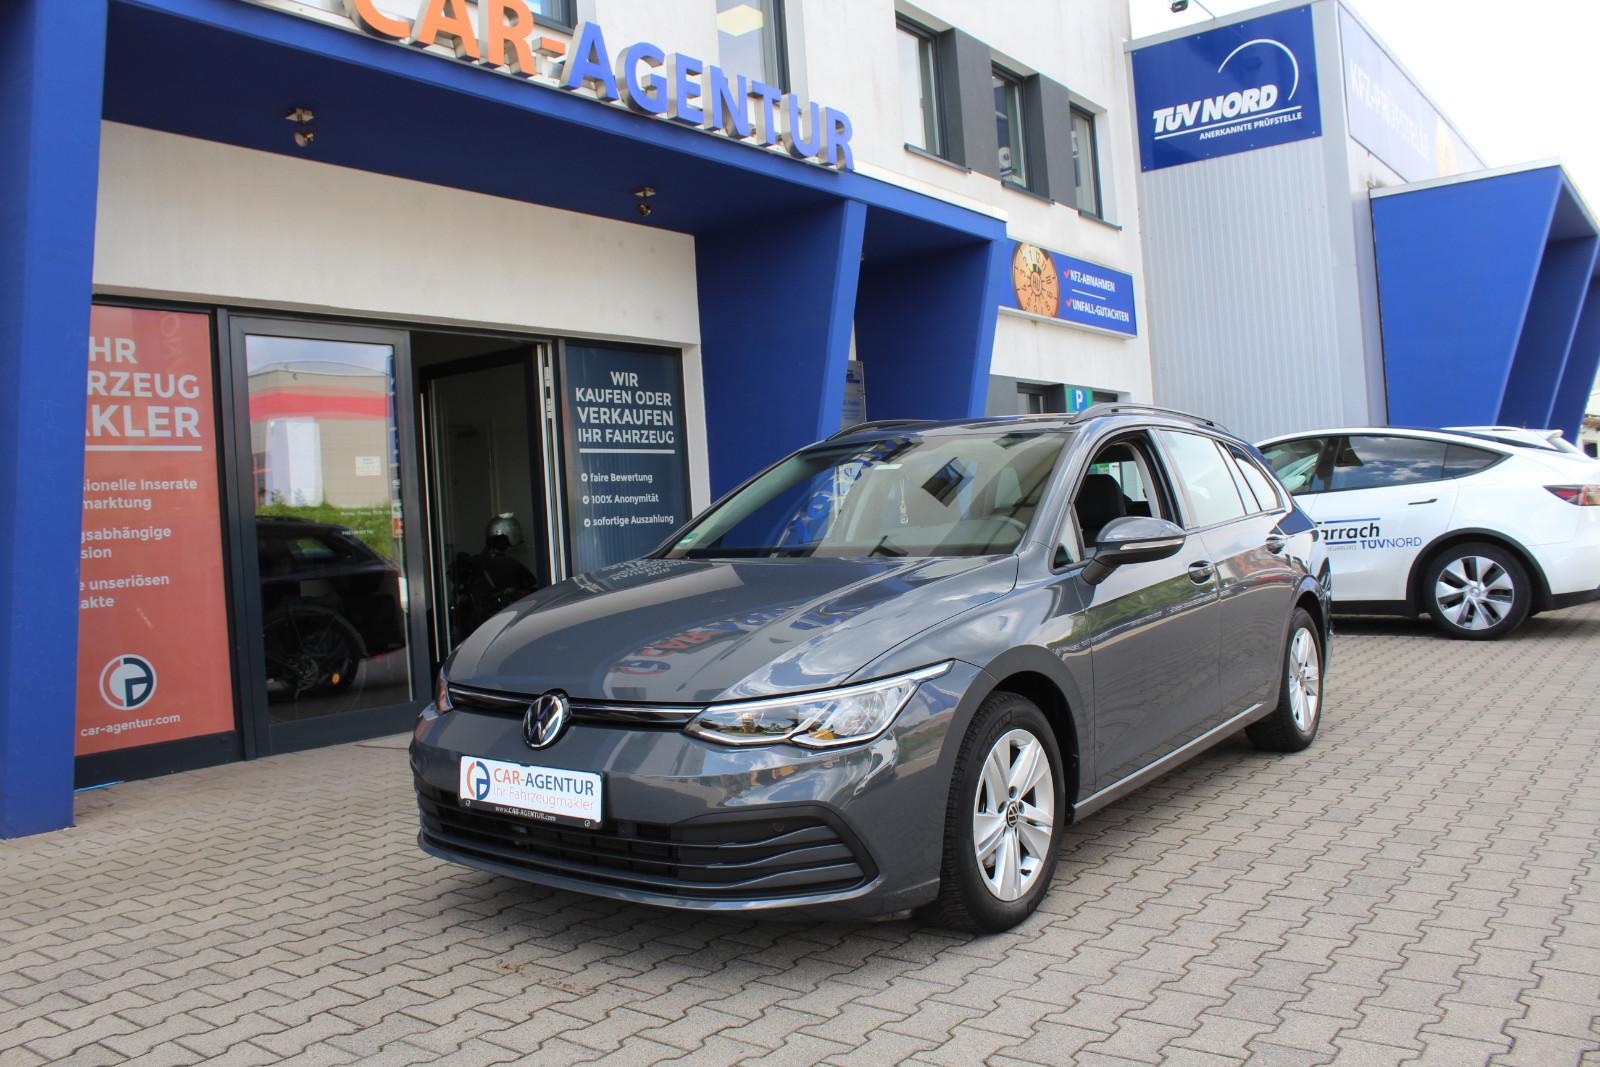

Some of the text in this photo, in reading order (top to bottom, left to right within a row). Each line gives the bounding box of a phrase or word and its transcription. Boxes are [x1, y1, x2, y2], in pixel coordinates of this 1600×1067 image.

[1201, 84, 1278, 123] NORD
[1199, 112, 1303, 140] ANERKANNTE PRÜFSTELLE
[1070, 270, 1115, 292] KFZ-ABNAHMEN
[1072, 299, 1130, 322] UNFALL-GUTACHTEN
[610, 371, 639, 387] WIR
[575, 387, 672, 406] KAUFEN ODER
[1075, 389, 1084, 409] P
[85, 404, 201, 437] KLER
[577, 406, 674, 426] VERKAUFEN
[578, 428, 675, 444] IHR FAHRZEUG
[83, 478, 198, 492] ionelle Inserate
[590, 473, 653, 484] faire Bewertung
[591, 493, 659, 505] 100% Anonymität
[592, 514, 674, 527] sofortige Auszahlung
[89, 574, 170, 591] unseriösen
[80, 712, 181, 738] car-agentur.com
[493, 767, 594, 796] CAR-AGENTUR
[509, 786, 593, 811] Fahrzeugmakler
